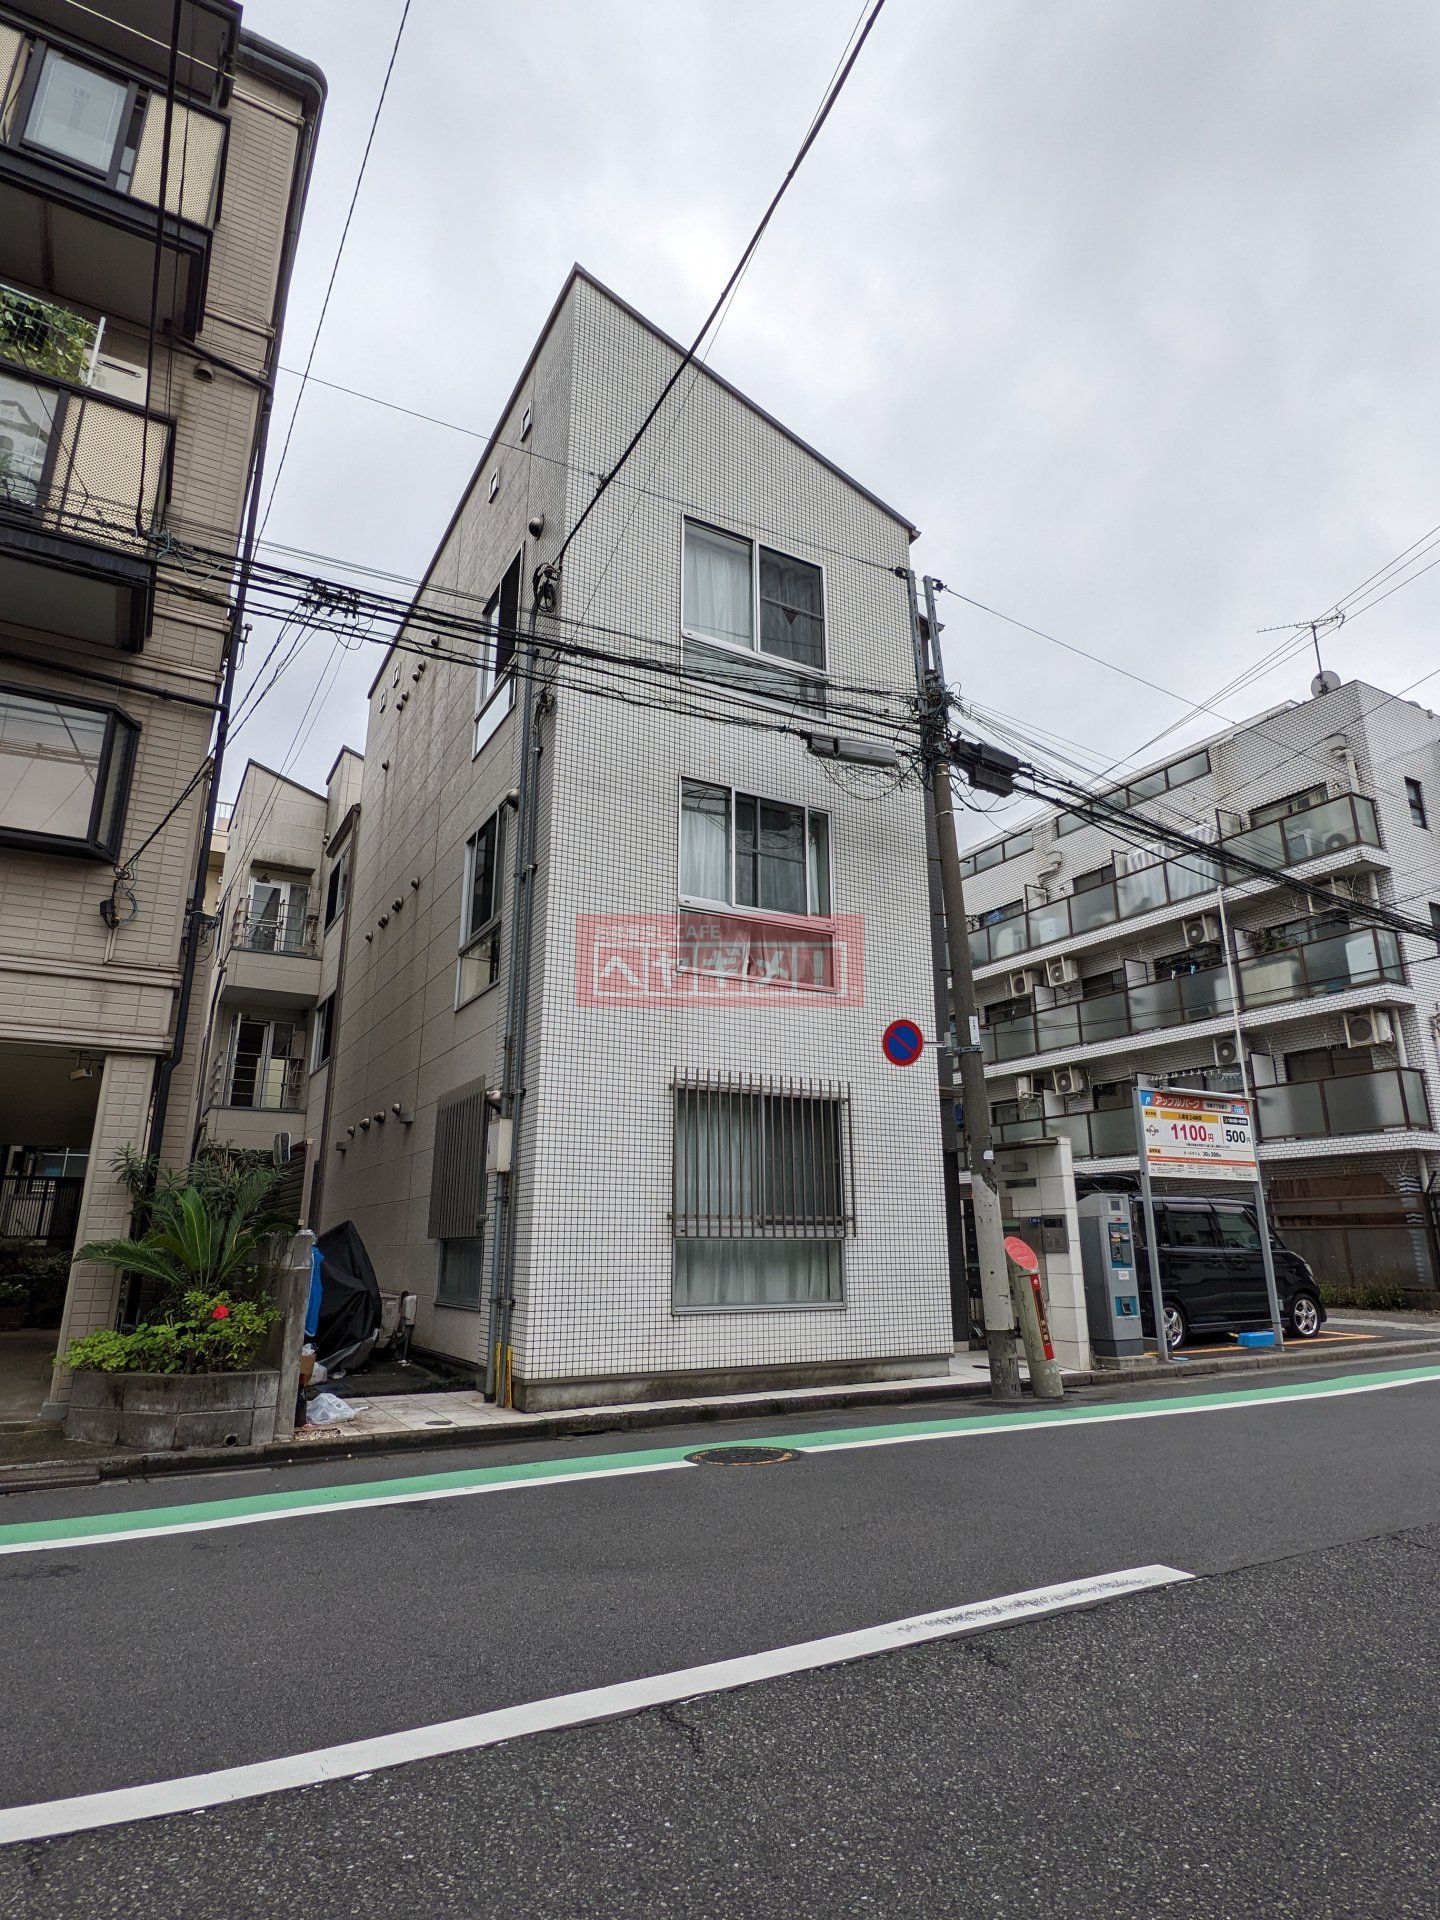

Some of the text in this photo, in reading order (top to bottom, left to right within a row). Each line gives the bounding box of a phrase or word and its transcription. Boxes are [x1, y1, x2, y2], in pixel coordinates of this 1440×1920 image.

[1154, 1095, 1201, 1109] アップルパーク
